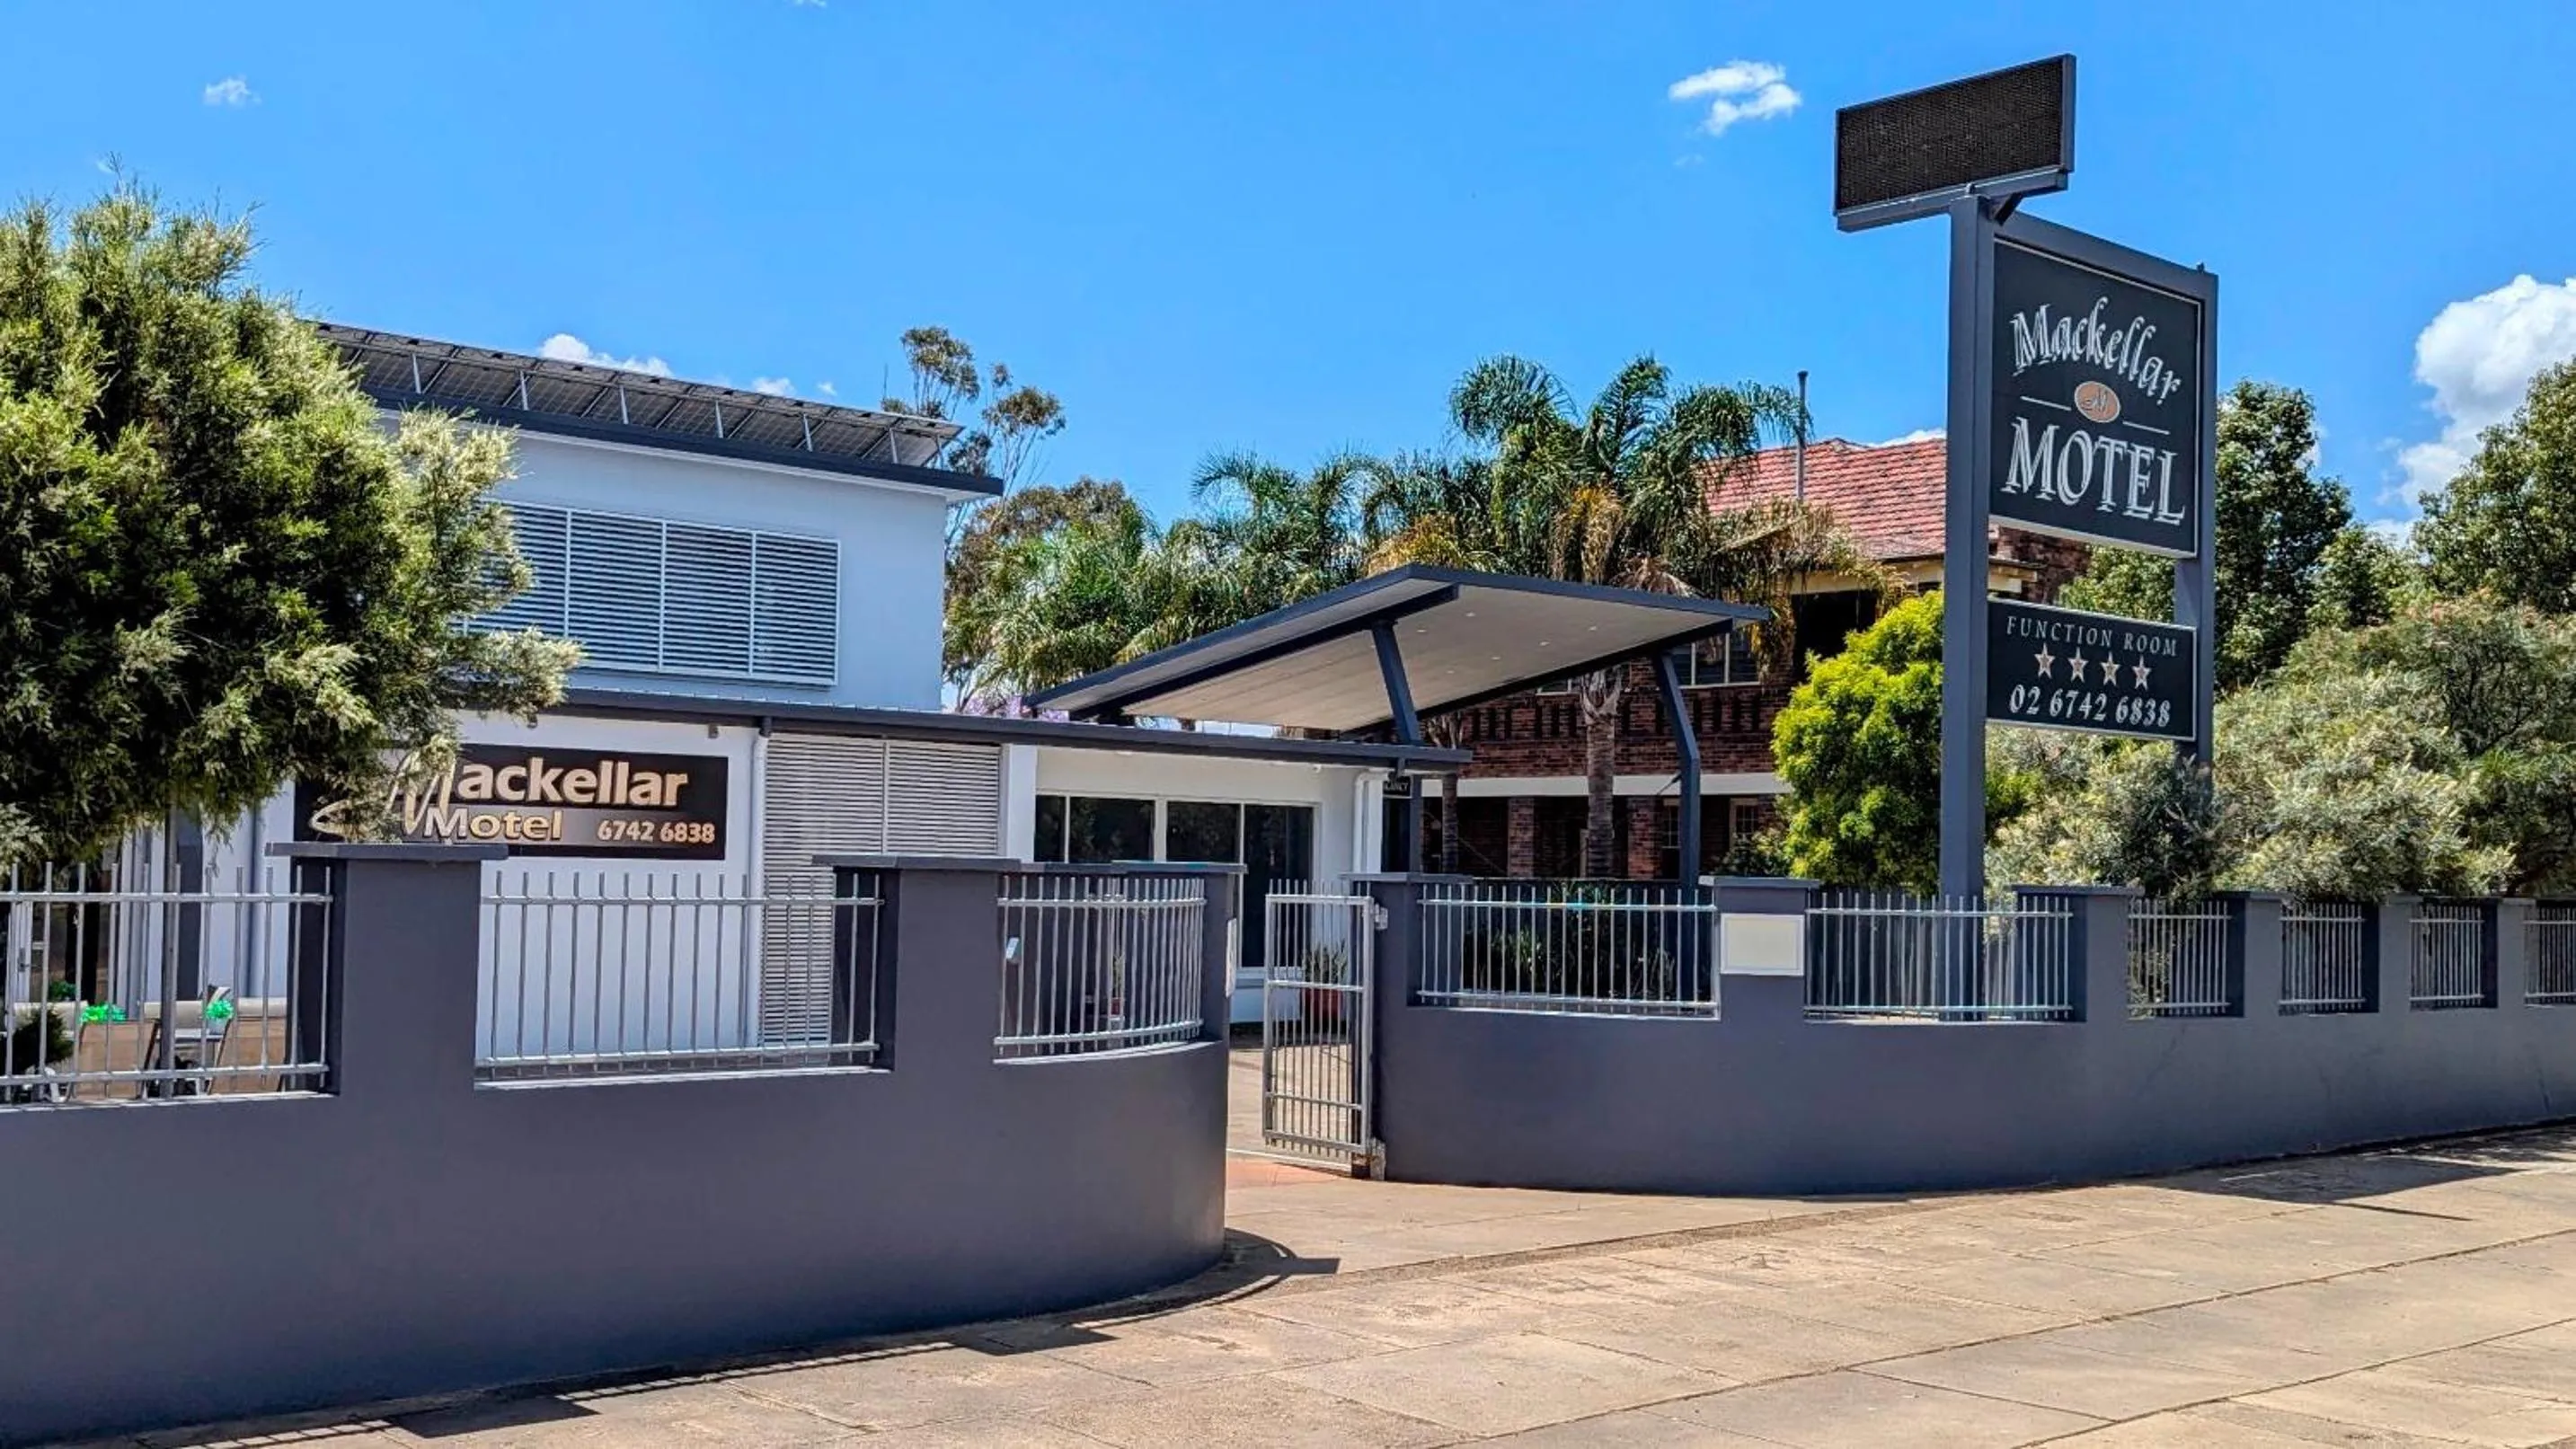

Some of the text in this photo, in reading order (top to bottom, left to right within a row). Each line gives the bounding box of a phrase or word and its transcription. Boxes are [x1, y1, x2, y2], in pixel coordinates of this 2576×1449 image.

[2009, 296, 2182, 405] Mackellar
[2000, 416, 2185, 526] MOTEL
[2006, 615, 2178, 658] FUNCTION ROOM
[2009, 684, 2171, 728] 02 6742 6838
[423, 806, 563, 841] Motel
[597, 819, 716, 844] 6742 6838
